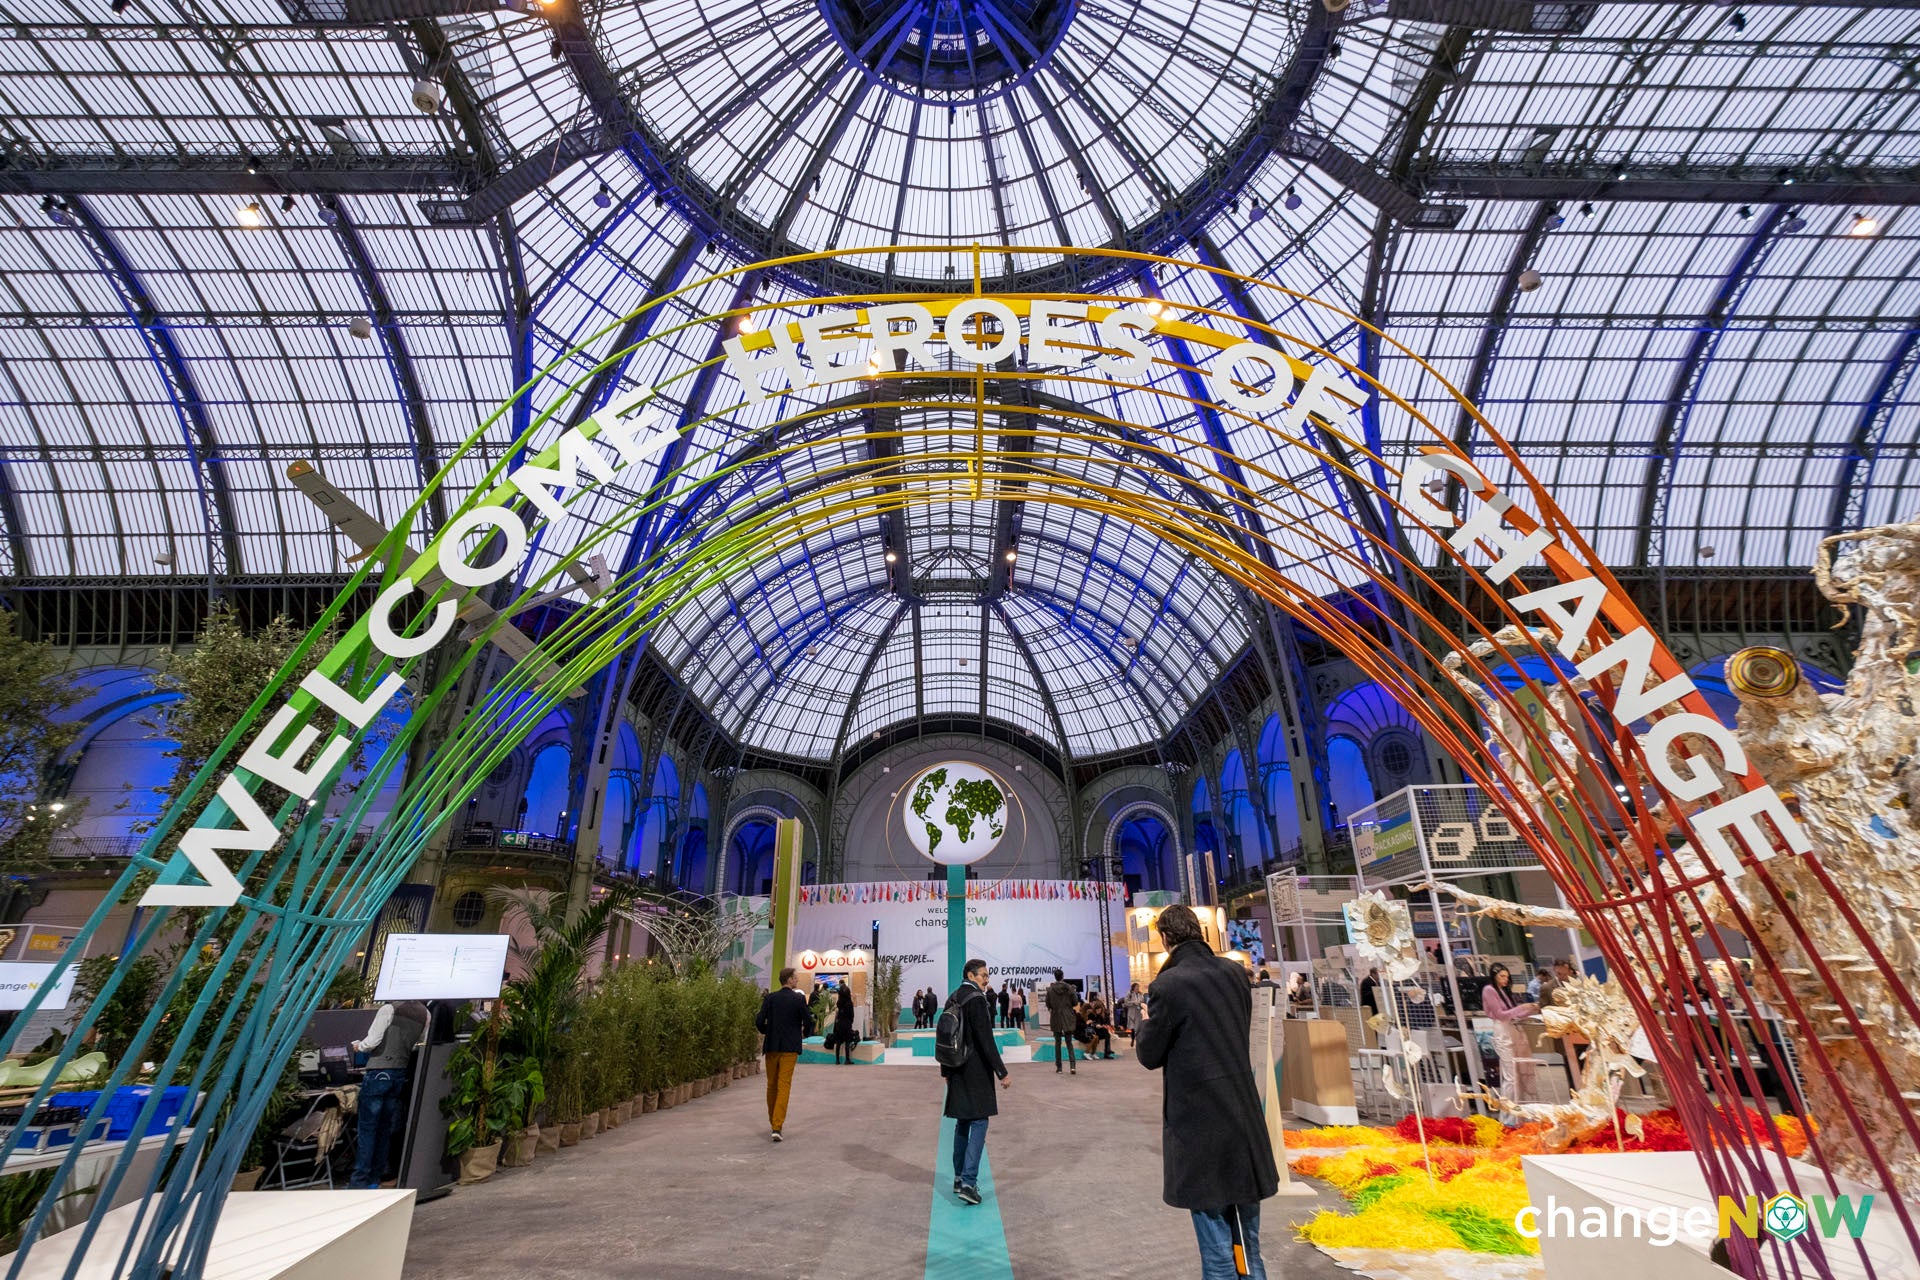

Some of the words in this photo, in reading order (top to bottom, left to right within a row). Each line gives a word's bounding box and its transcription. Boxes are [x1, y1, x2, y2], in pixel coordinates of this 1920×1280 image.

[137, 384, 682, 907] WELCOME
[723, 298, 1158, 406] HEROES
[1212, 342, 1370, 432] OF
[1402, 453, 1814, 878] CHANGE
[820, 956, 865, 967] VEOLIA
[988, 966, 999, 976] DO
